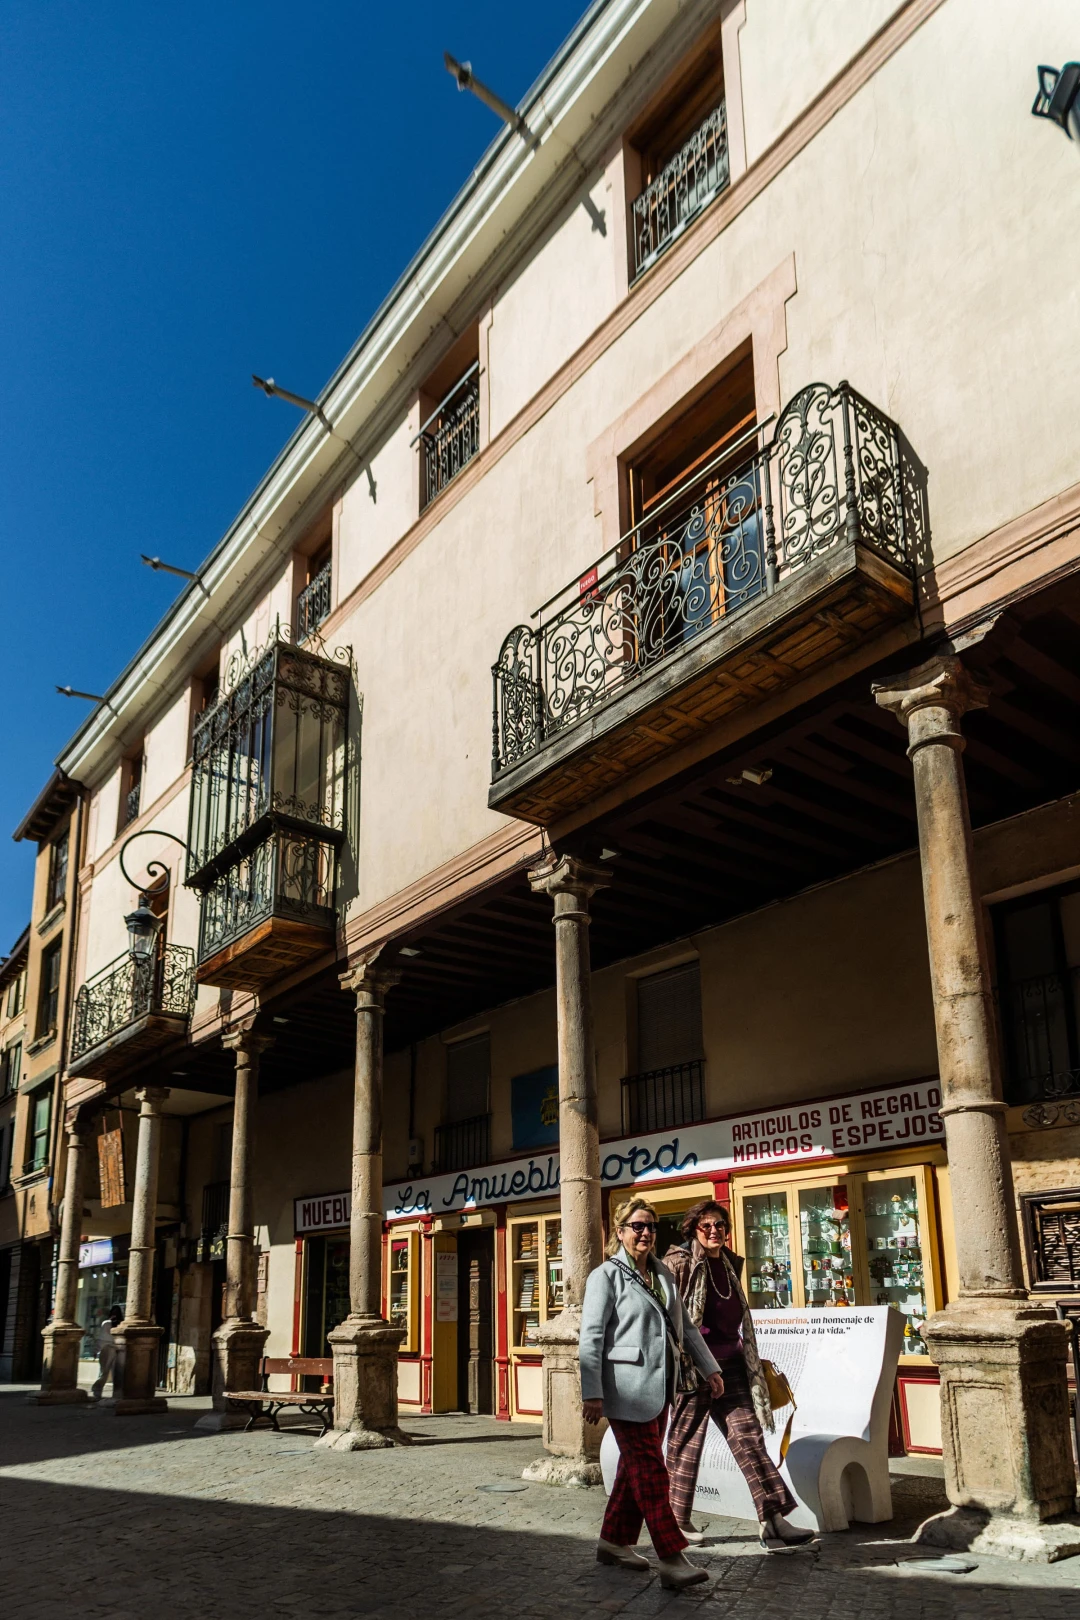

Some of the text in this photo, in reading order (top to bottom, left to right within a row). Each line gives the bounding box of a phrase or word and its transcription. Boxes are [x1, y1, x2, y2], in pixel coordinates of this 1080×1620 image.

[732, 1088, 941, 1141] ARTICULOS DE REGALO
[832, 1113, 944, 1149] ESPEJOS
[394, 1137, 699, 1215] La Amueblora
[302, 1197, 351, 1227] MUEBL
[770, 1327, 777, 1335] la
[777, 1327, 805, 1335] música
[805, 1328, 811, 1336] y
[818, 1327, 825, 1335] la
[823, 1316, 863, 1325] homenaje
[864, 1316, 875, 1324] de
[695, 1485, 720, 1496] ORAMA
